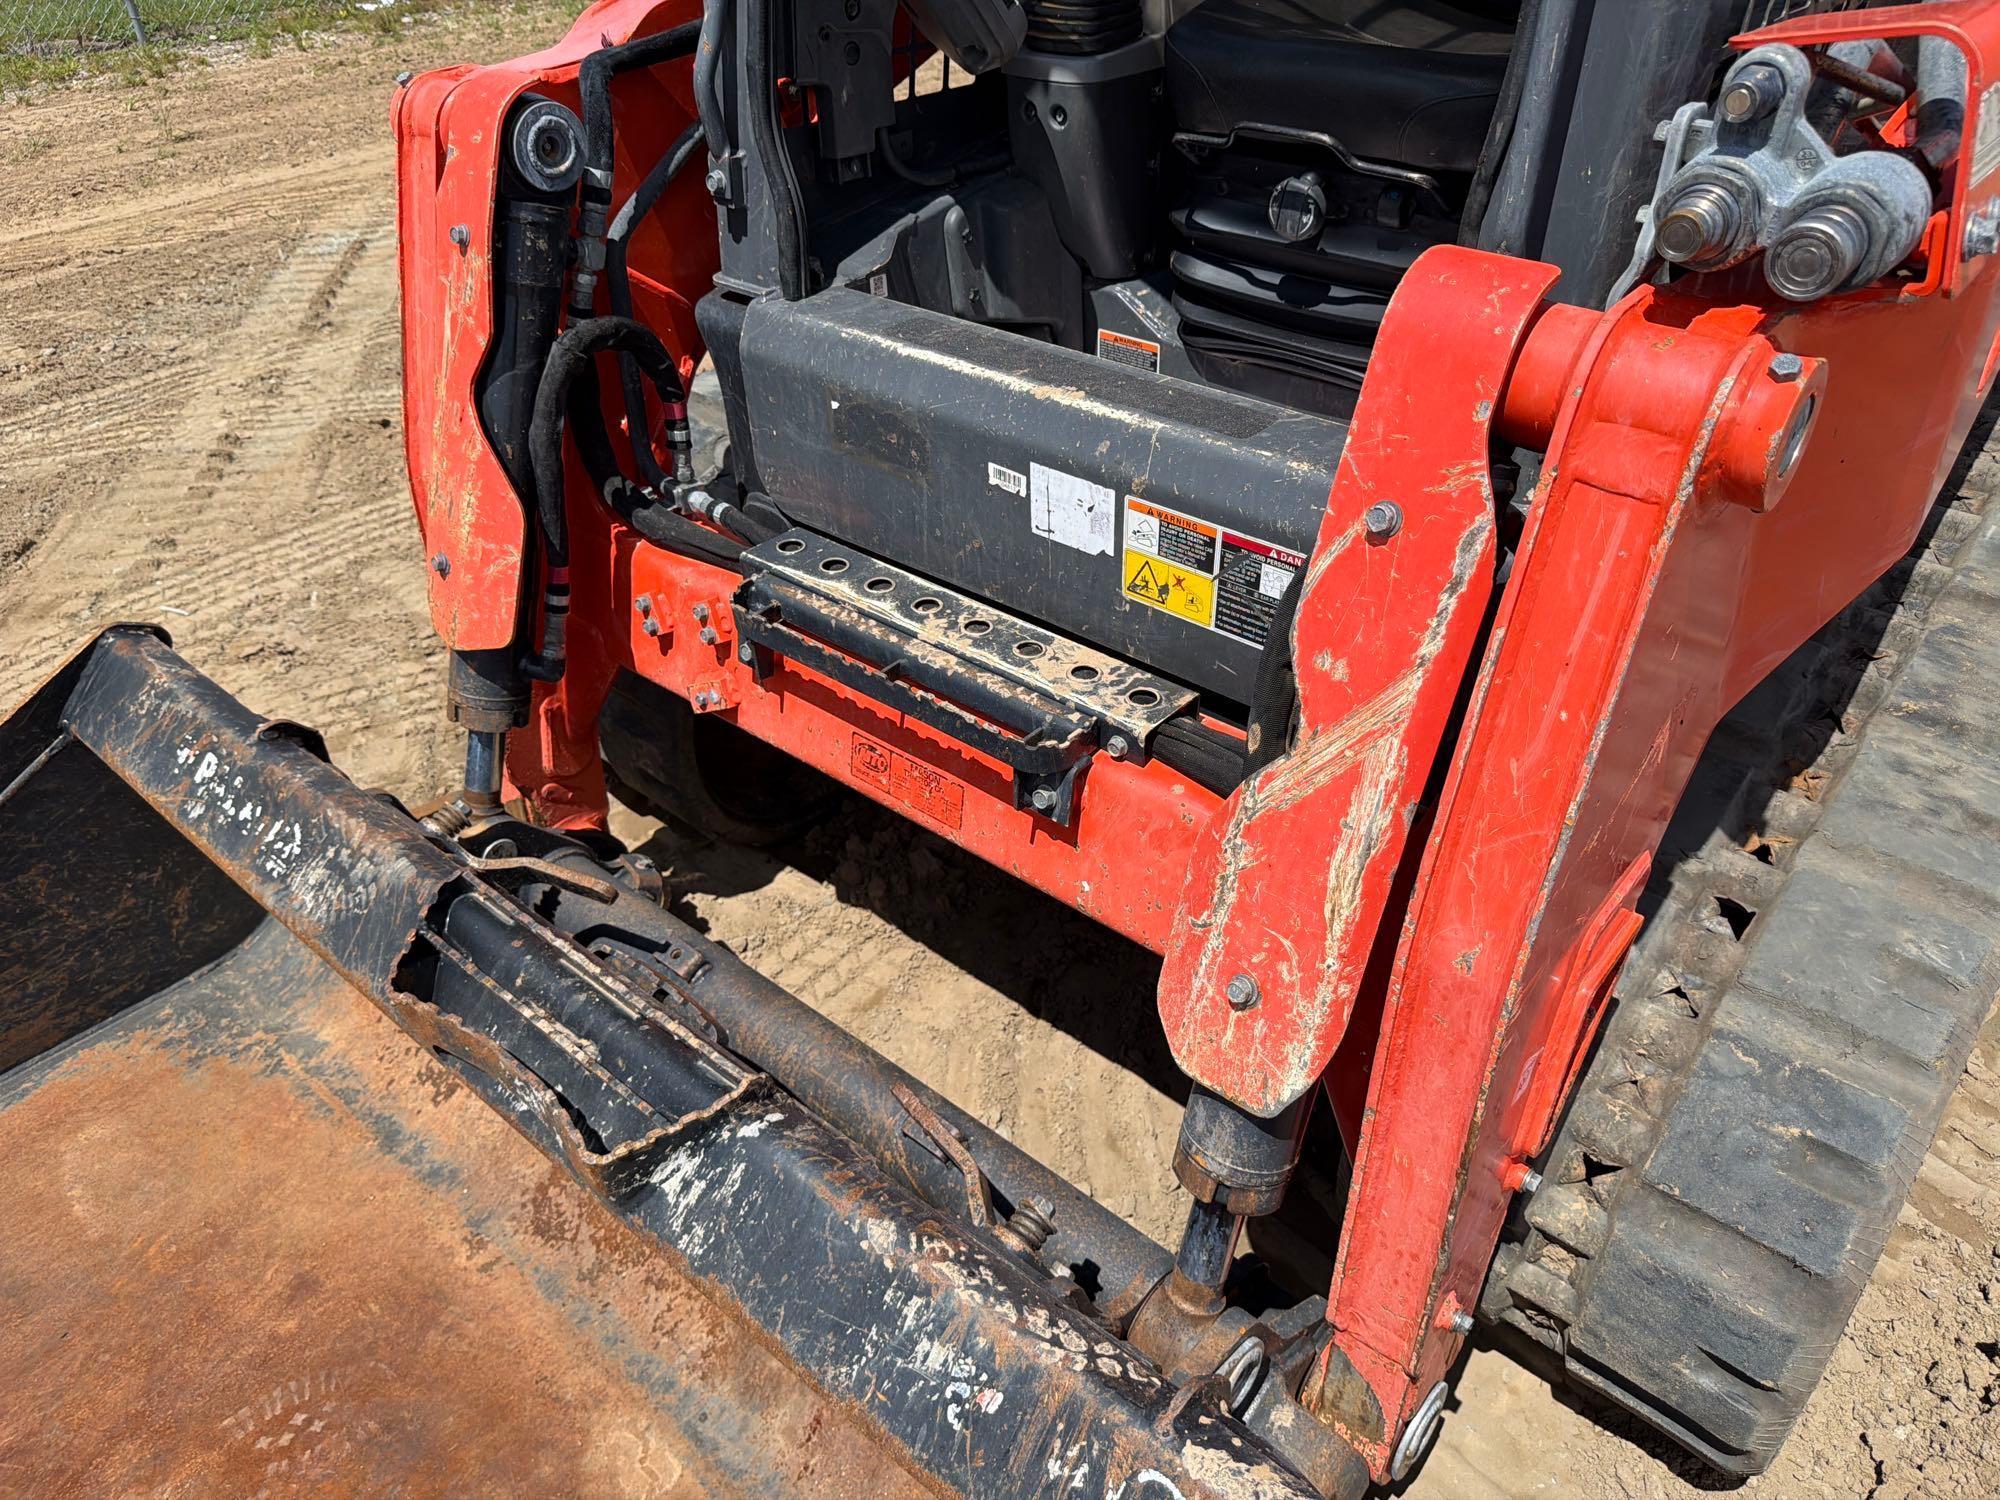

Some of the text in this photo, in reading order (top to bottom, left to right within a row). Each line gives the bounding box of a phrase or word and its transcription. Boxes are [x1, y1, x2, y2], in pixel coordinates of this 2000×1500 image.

[1156, 511, 1198, 530] WARNING
[1183, 529, 1210, 542] PERSONAL
[1266, 557, 1295, 573] PERSONAL
